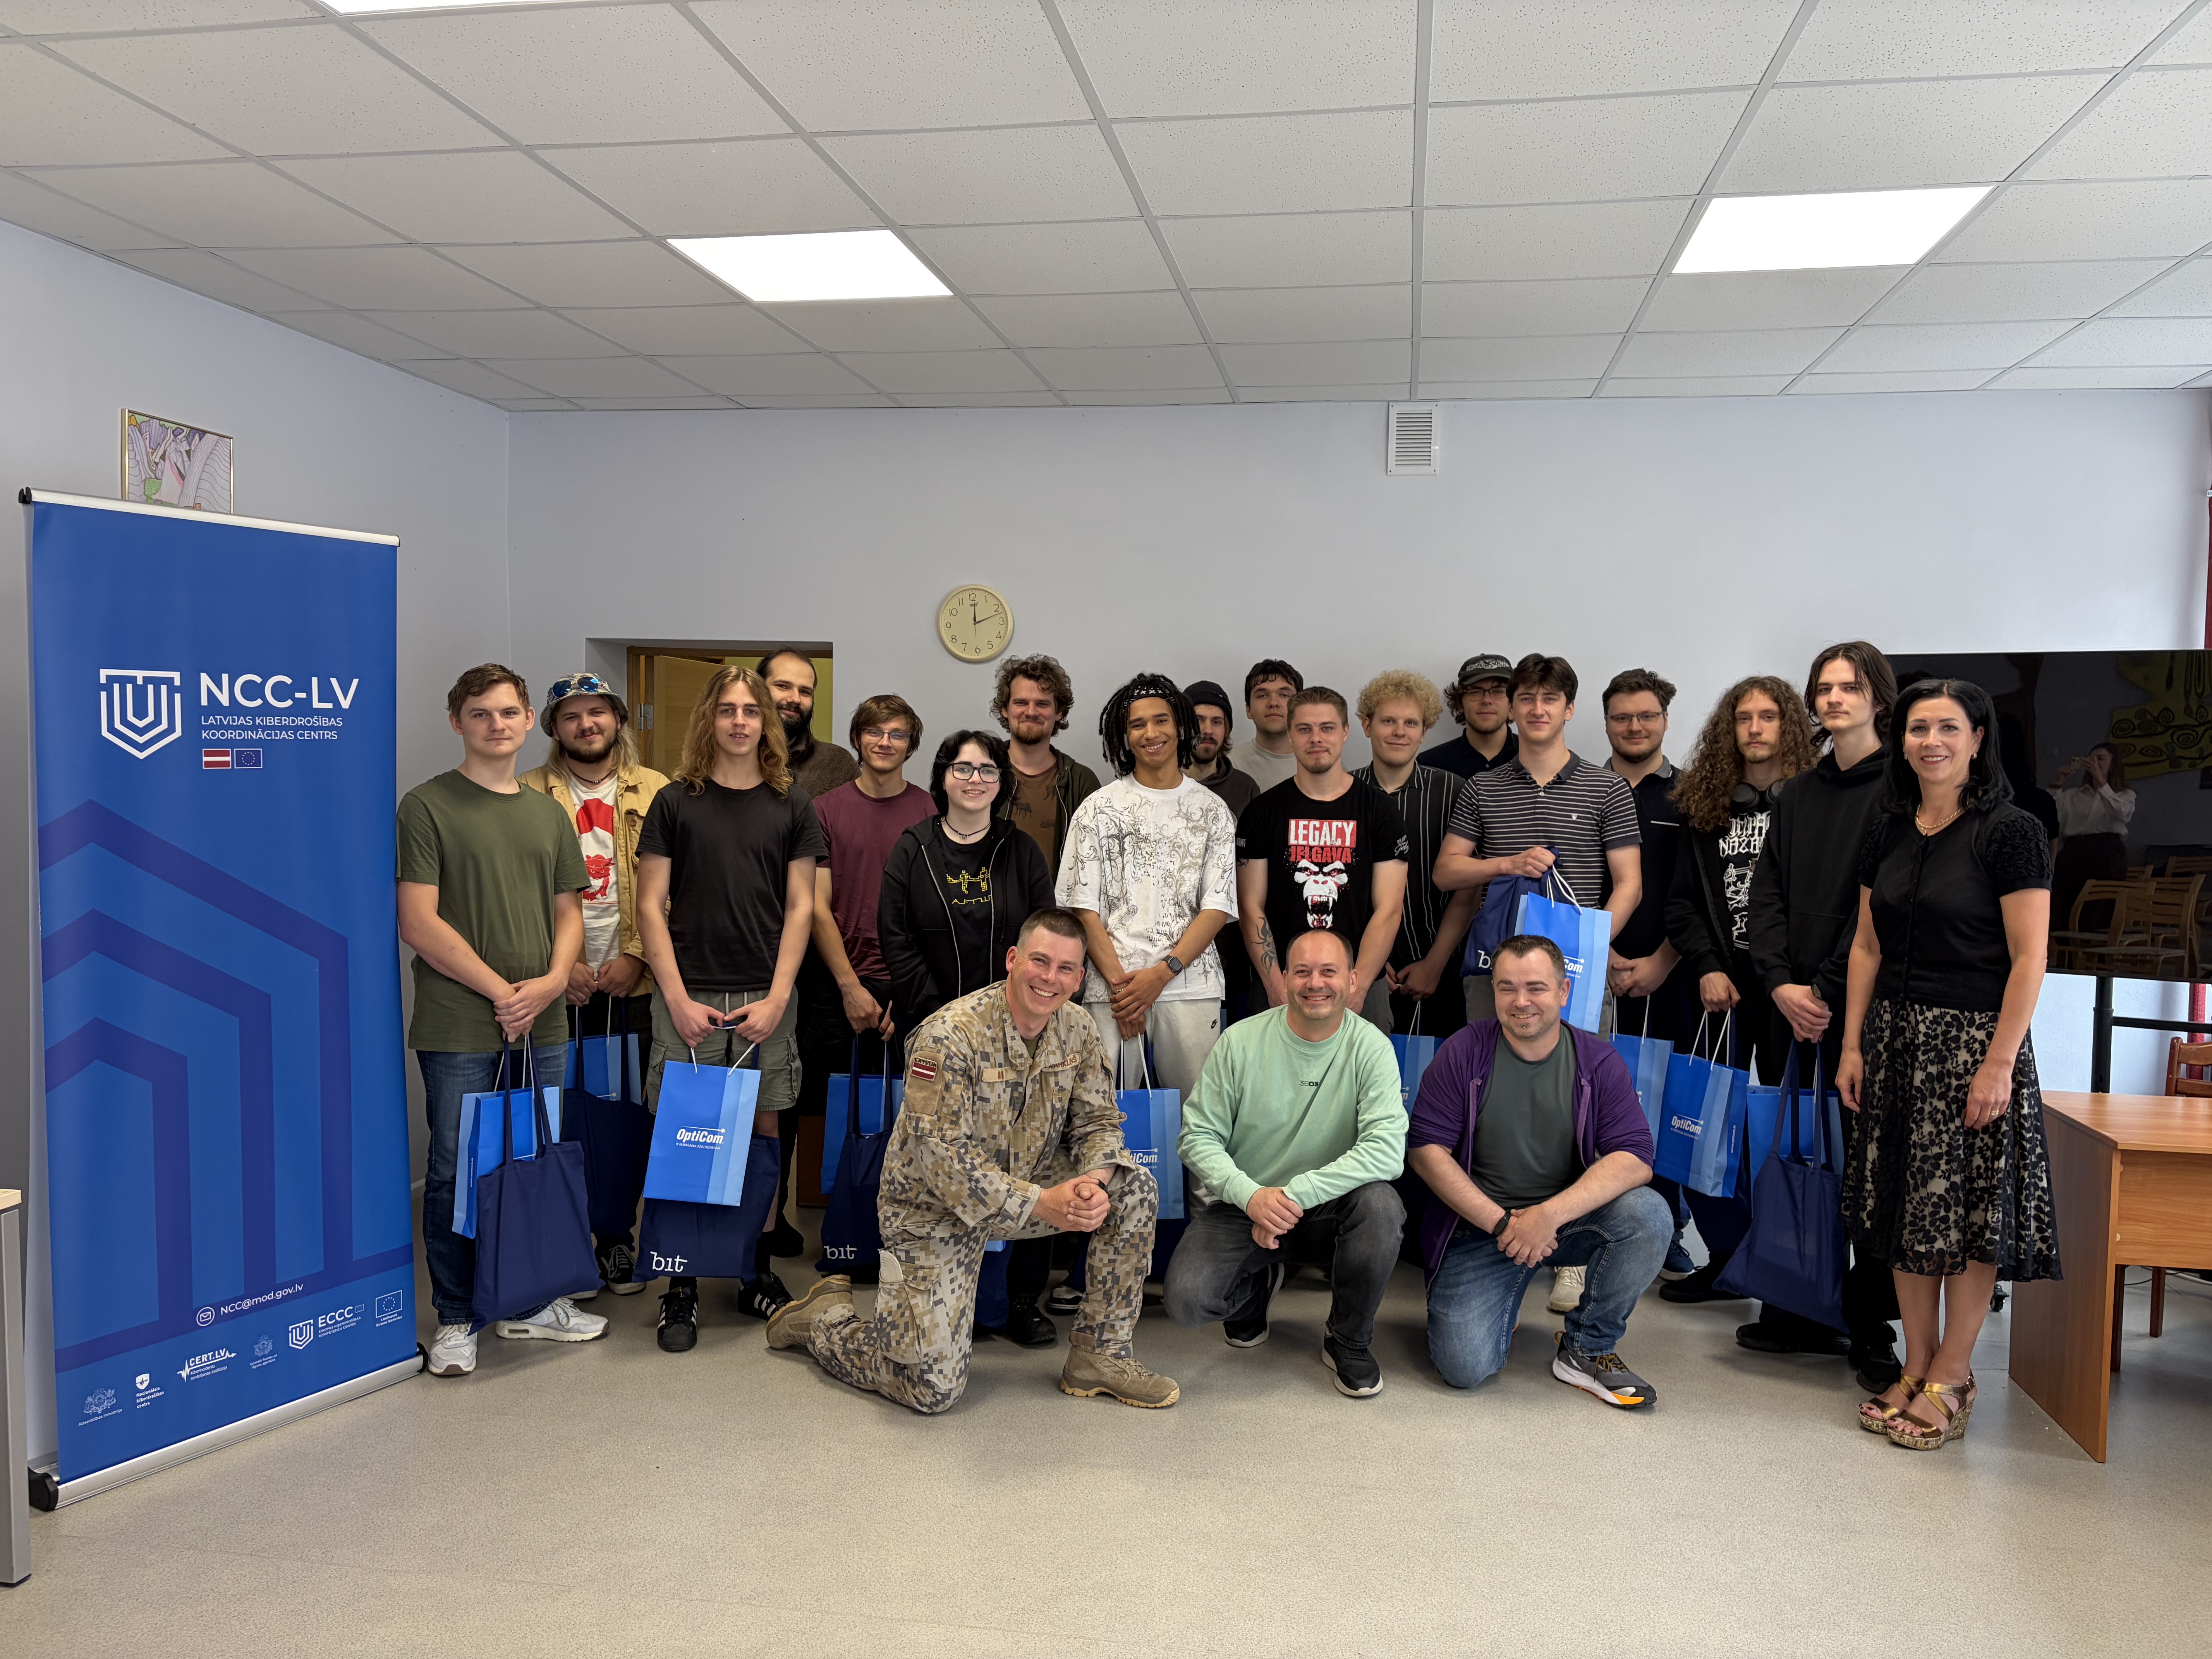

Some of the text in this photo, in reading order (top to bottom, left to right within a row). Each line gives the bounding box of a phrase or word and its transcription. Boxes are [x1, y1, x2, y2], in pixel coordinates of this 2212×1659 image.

[958, 598, 964, 606] 11
[969, 593, 976, 601] 12
[949, 608, 958, 617] 10
[993, 603, 999, 612] 2
[946, 622, 951, 630] 9
[998, 617, 1005, 625] 3
[951, 634, 957, 643] 8
[962, 643, 967, 651] 7
[975, 646, 981, 654] 6
[987, 641, 993, 649] 5
[200, 672, 359, 709] NCC-LV
[201, 716, 343, 726] LATVIJAS KIBERDROŠĪBAS
[202, 728, 338, 740] KOORDINĀCIJAS CENTRS
[1290, 820, 1355, 846] LEGACY
[1290, 846, 1352, 863] JELGAVA
[1671, 1115, 1702, 1134] OptiCom
[677, 1128, 724, 1144] OptiCom
[824, 1244, 857, 1259] bit
[650, 1251, 688, 1272] bit
[221, 1284, 303, 1315] NCC@mod.gov.lv
[319, 1306, 353, 1328] ECCC
[189, 1348, 226, 1366] CERT.LV
